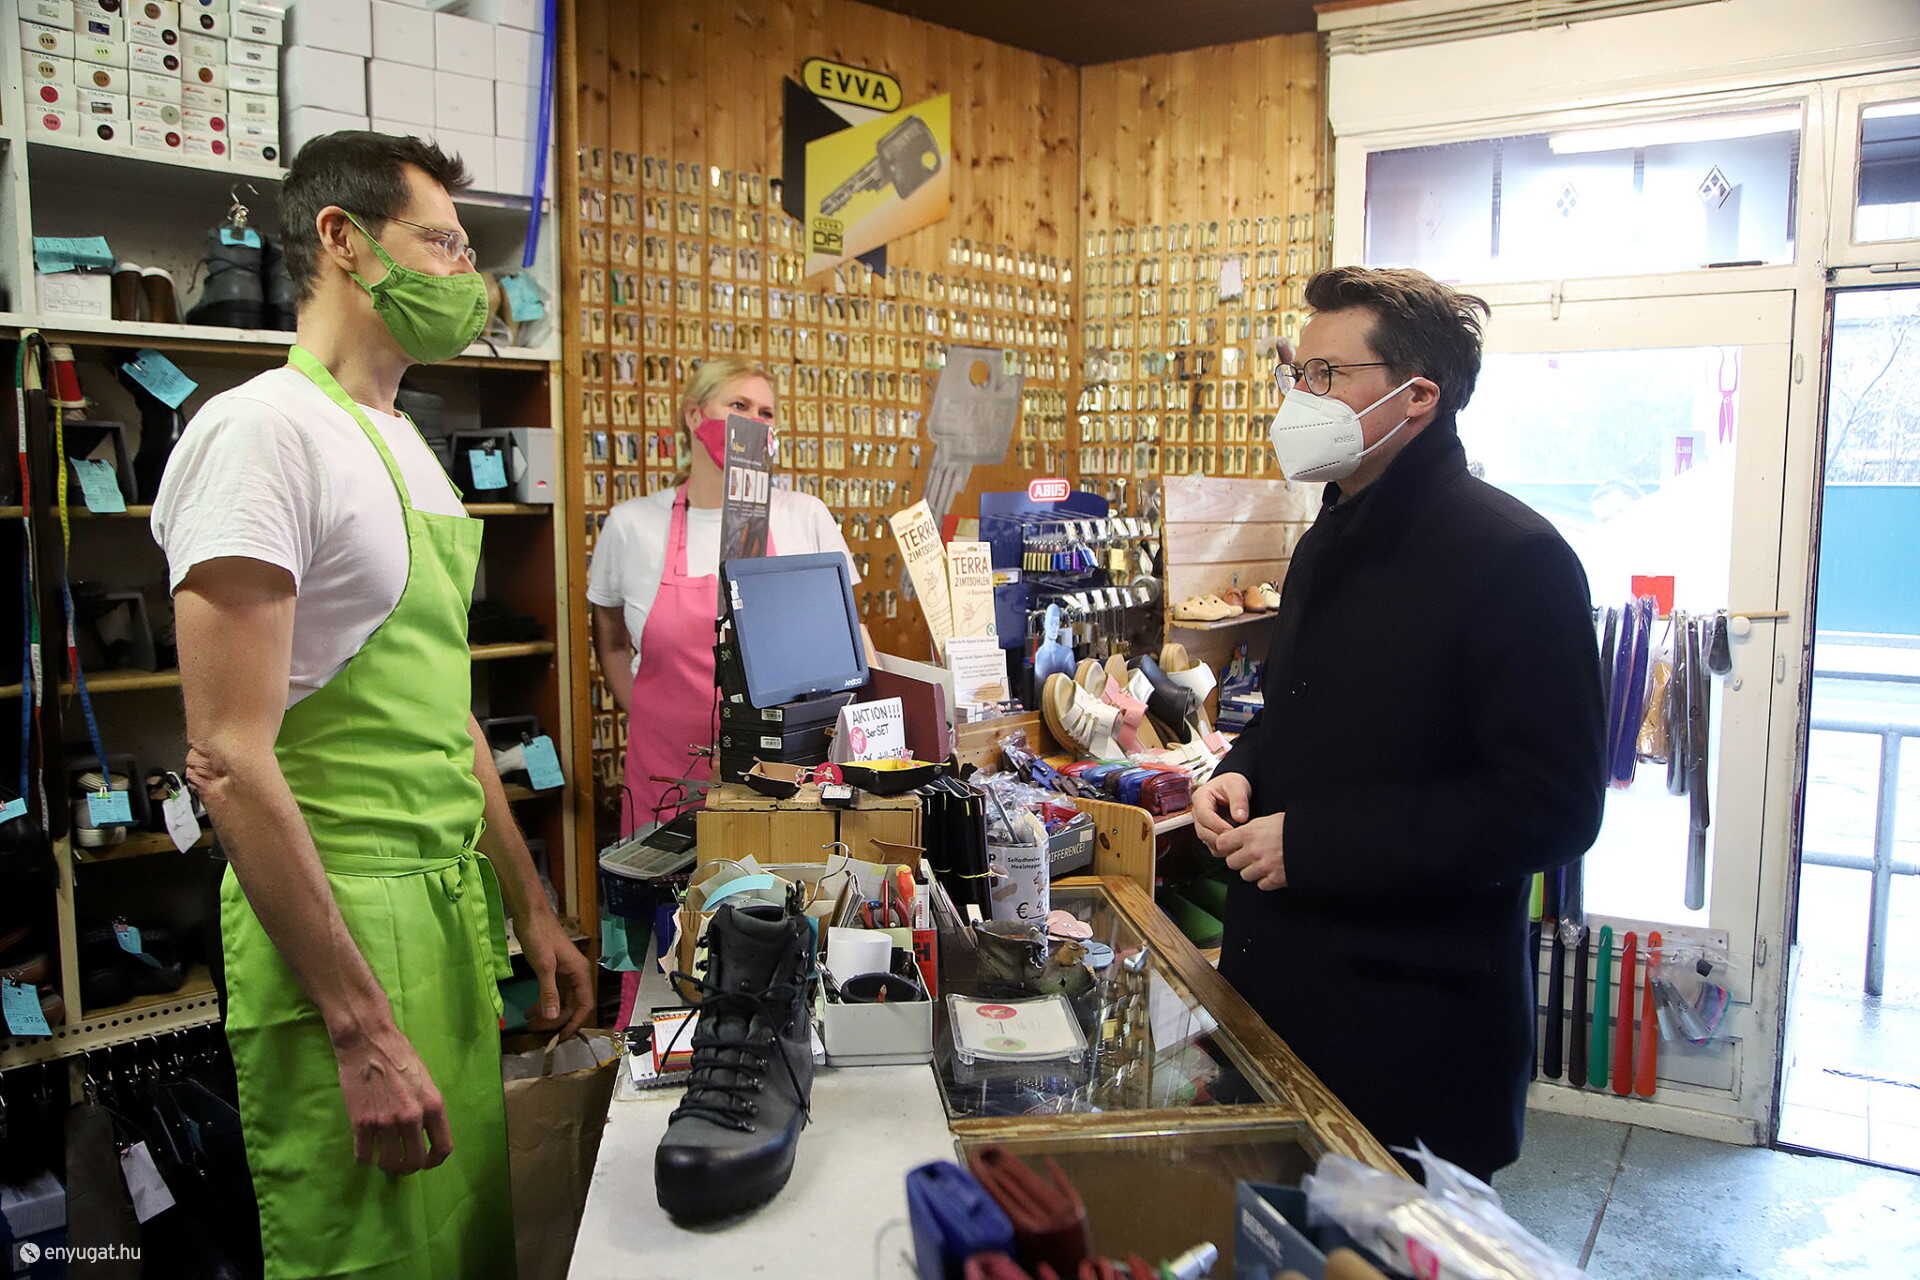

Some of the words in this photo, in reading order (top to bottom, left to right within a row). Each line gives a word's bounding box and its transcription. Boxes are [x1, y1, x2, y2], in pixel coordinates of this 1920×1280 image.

[820, 67, 888, 103] EVVA
[1032, 483, 1066, 498] ABUS
[952, 556, 989, 575] TERRA
[852, 704, 901, 725] AKTION!!!
